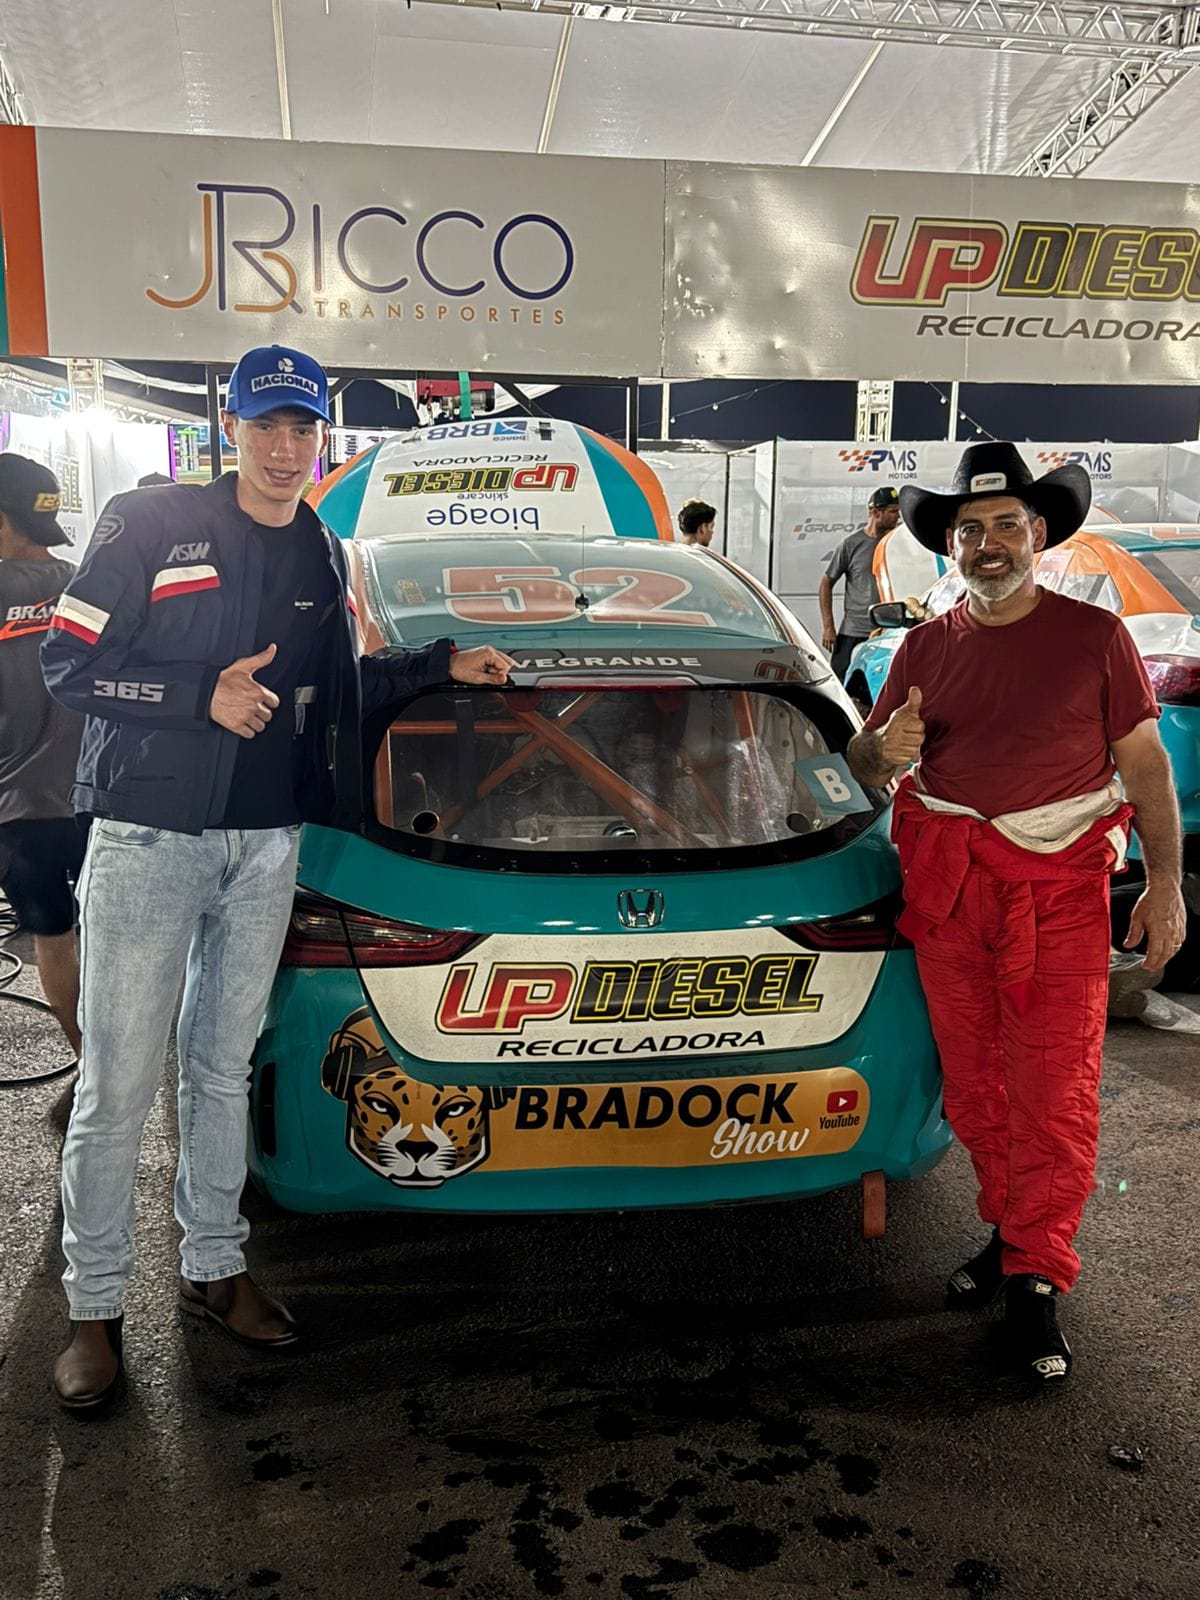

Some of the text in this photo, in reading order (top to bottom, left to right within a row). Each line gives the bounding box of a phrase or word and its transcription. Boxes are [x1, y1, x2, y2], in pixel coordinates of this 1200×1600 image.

[850, 215, 1200, 307] UP DIES
[315, 300, 566, 326] TRANSPORTES
[253, 374, 317, 394] NACIONAL
[427, 422, 492, 440] BRB
[413, 454, 548, 467] RECICLADORA
[383, 463, 579, 497] UP DIESEL
[888, 472, 918, 480] MOTORS
[457, 492, 509, 501] skincare
[426, 503, 540, 531] bioage
[804, 523, 855, 533] GRUPO
[441, 566, 718, 629] 52
[94, 679, 166, 702] 365
[813, 767, 851, 803] B
[434, 953, 824, 1036] UP DIESEL
[496, 1030, 766, 1057] RECICLADORA
[514, 1081, 799, 1130] BRADOCK
[819, 1113, 860, 1130] YouTube
[709, 1117, 810, 1160] Show
[1036, 1358, 1067, 1374] OMP
